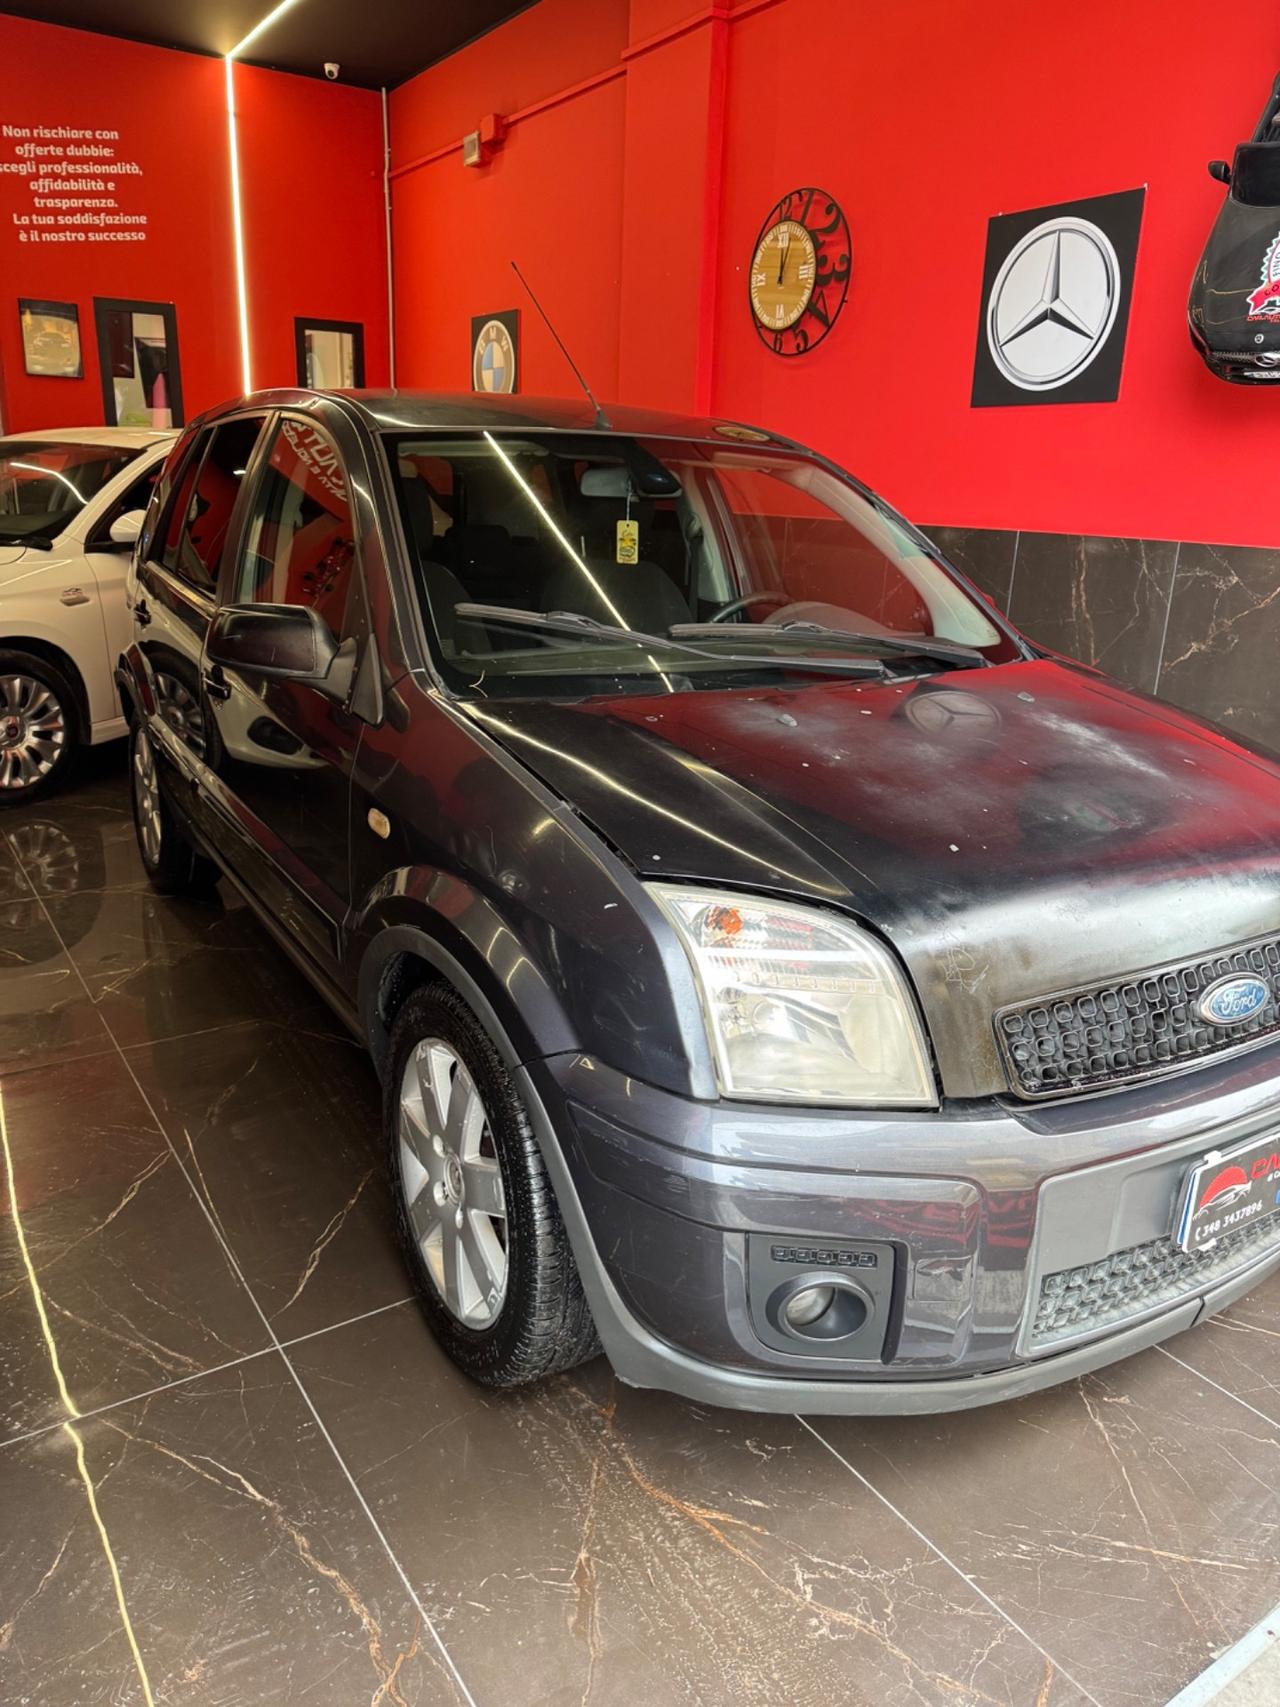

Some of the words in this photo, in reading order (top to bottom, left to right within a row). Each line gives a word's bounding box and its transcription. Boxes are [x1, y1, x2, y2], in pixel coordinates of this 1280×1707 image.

[2, 125, 31, 138] Non
[33, 126, 93, 139] rischiare
[95, 129, 119, 140] con
[15, 143, 64, 158] offerte
[66, 145, 114, 157] dubbie:
[38, 161, 143, 176] professionalità,
[29, 178, 105, 193] affidabilità
[107, 181, 115, 191] e
[34, 196, 118, 209] trasparenza.
[13, 213, 29, 225] La
[32, 214, 55, 225] tua
[57, 213, 147, 227] soddisfazione
[19, 230, 28, 242] è
[30, 231, 39, 242] il
[42, 231, 86, 242] nostro
[88, 231, 146, 241] successo
[1220, 986, 1257, 1015] Ford
